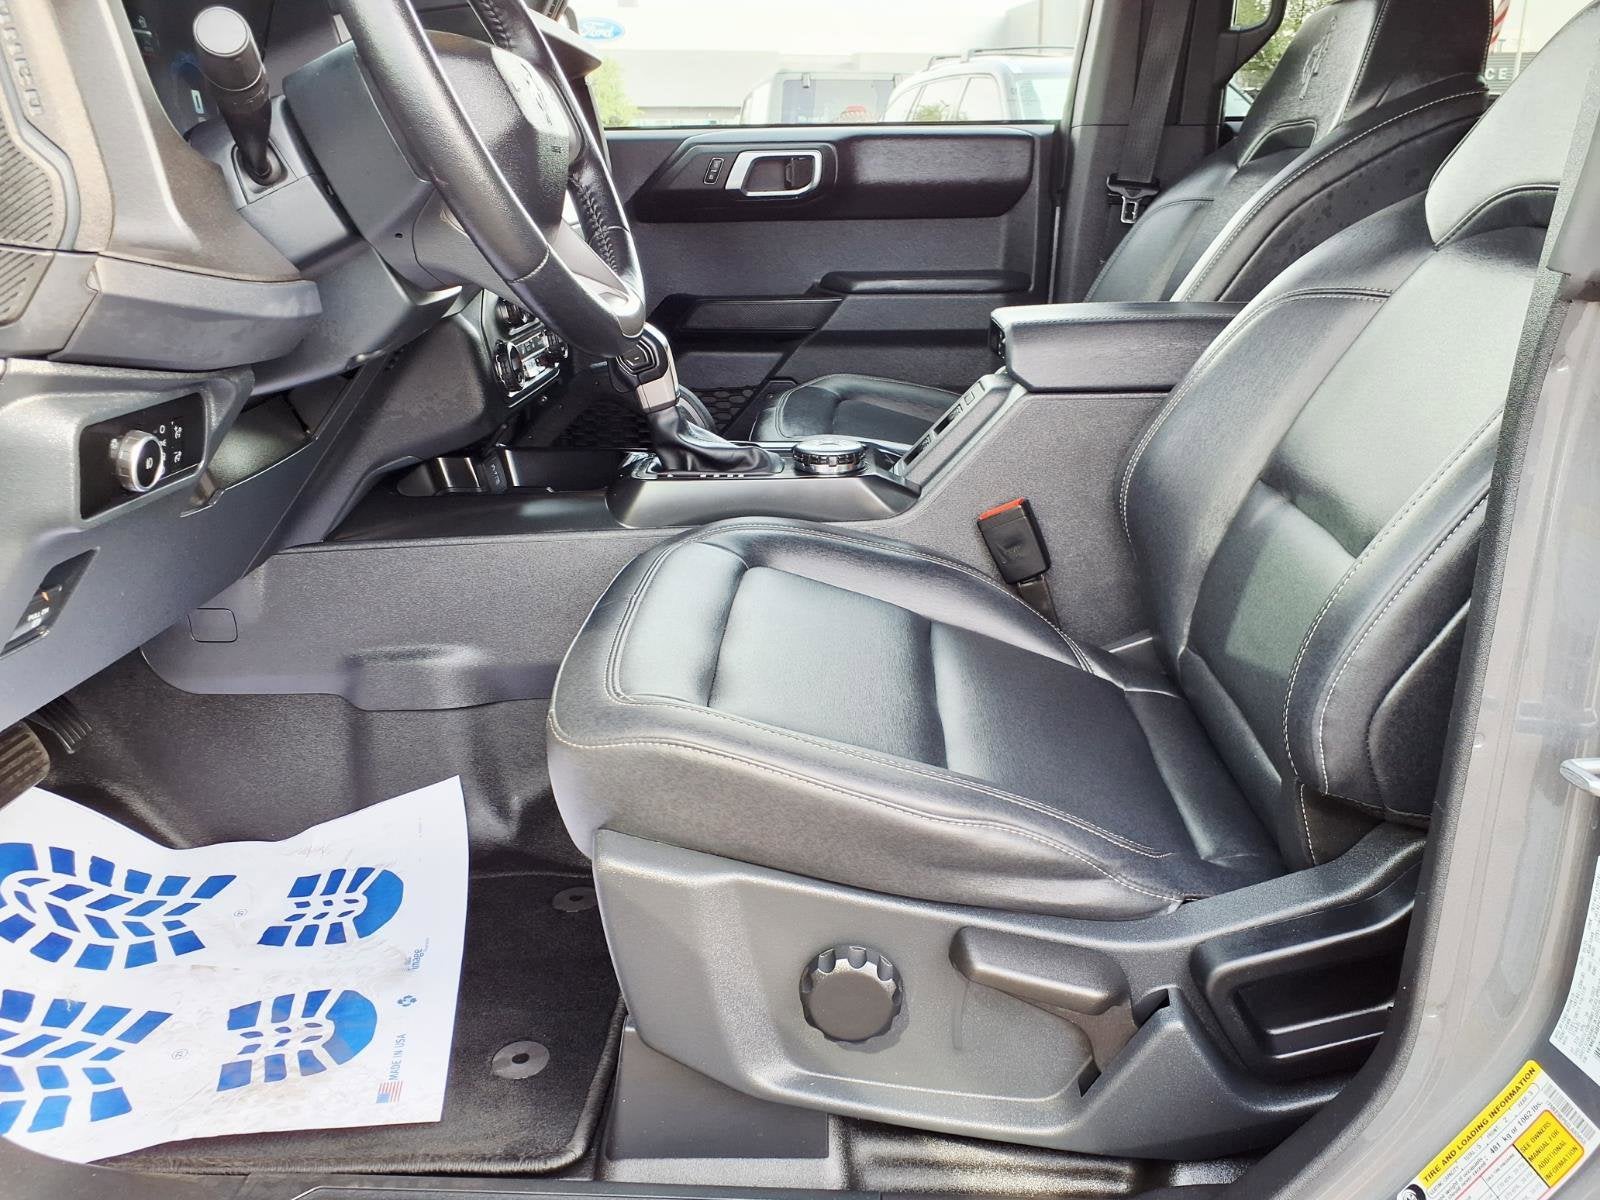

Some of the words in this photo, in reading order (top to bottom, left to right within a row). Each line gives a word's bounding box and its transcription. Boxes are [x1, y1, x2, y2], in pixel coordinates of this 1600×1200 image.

[389, 1060, 401, 1080] MADE
[396, 1033, 407, 1048] USA
[1424, 1164, 1441, 1183] TIRE
[1441, 1149, 1457, 1166] AND
[1456, 1118, 1489, 1150] LOADING
[1488, 1067, 1536, 1119] INFORMATION
